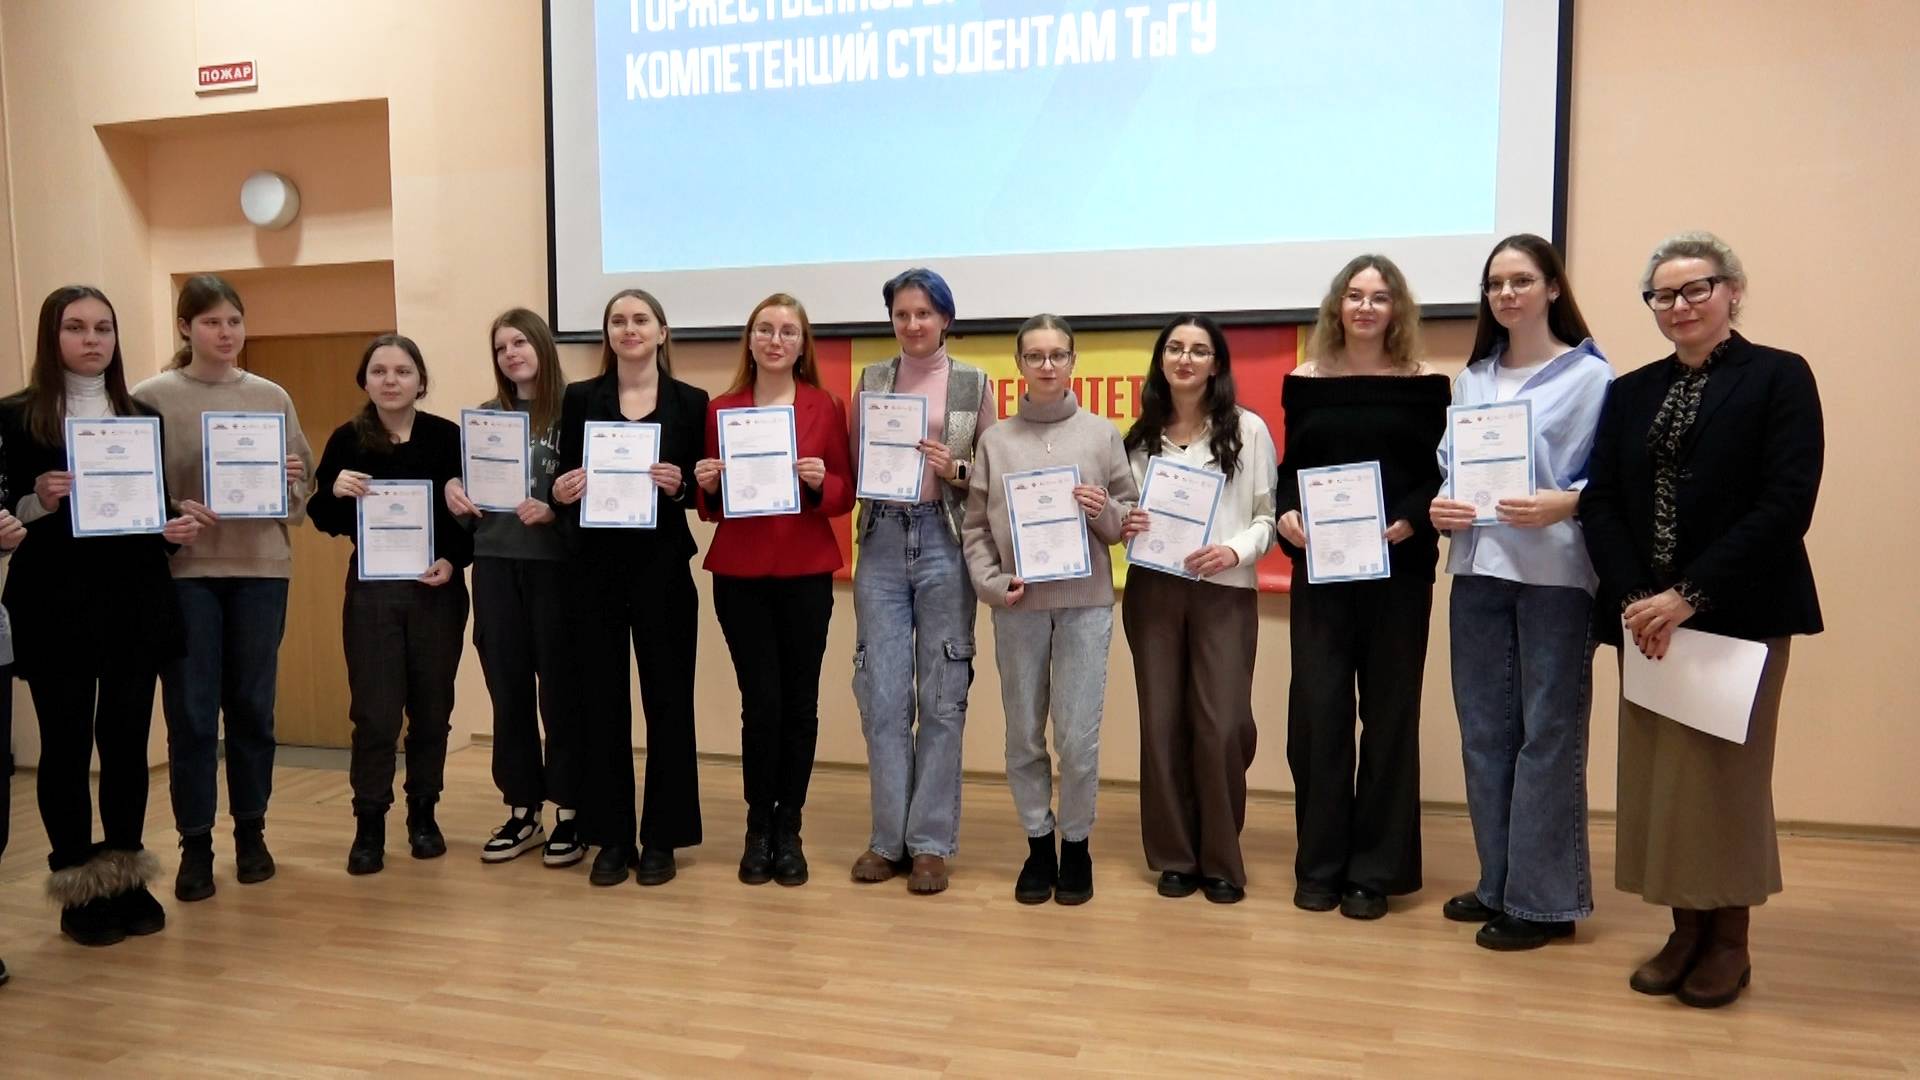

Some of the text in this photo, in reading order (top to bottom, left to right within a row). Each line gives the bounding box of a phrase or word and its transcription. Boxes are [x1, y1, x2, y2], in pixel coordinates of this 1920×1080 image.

[200, 65, 252, 82] ПОЖАР
[625, 0, 1217, 100] КОМПЕТЕНЦИЙ СТУДЕНТАМ ТвГУ
